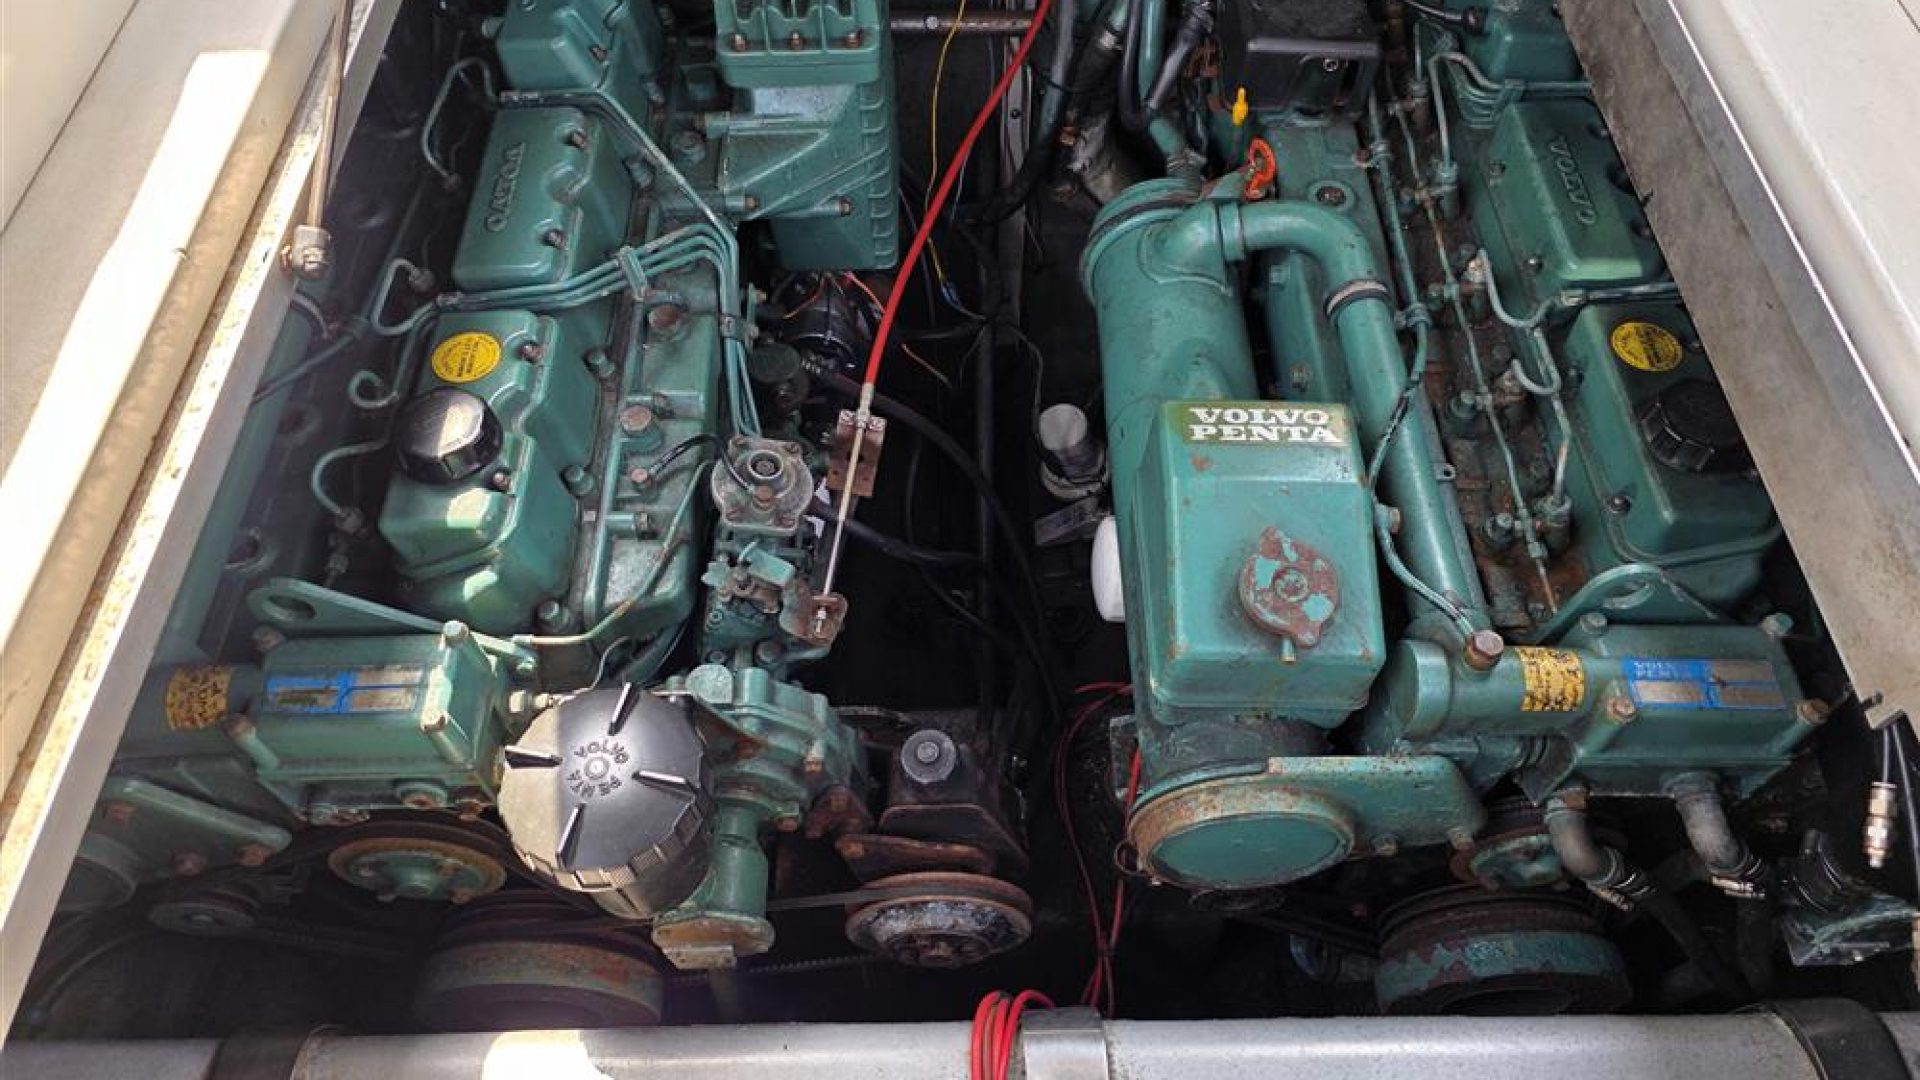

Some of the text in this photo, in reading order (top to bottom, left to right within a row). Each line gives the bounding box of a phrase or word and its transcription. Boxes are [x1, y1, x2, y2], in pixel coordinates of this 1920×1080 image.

[485, 142, 526, 232] VOLVO
[1551, 135, 1597, 226] VOLVO
[1189, 408, 1329, 424] VOLVO
[1189, 425, 1345, 442] PENTA
[573, 739, 630, 764] VOLVO
[566, 769, 623, 798] PENTA
